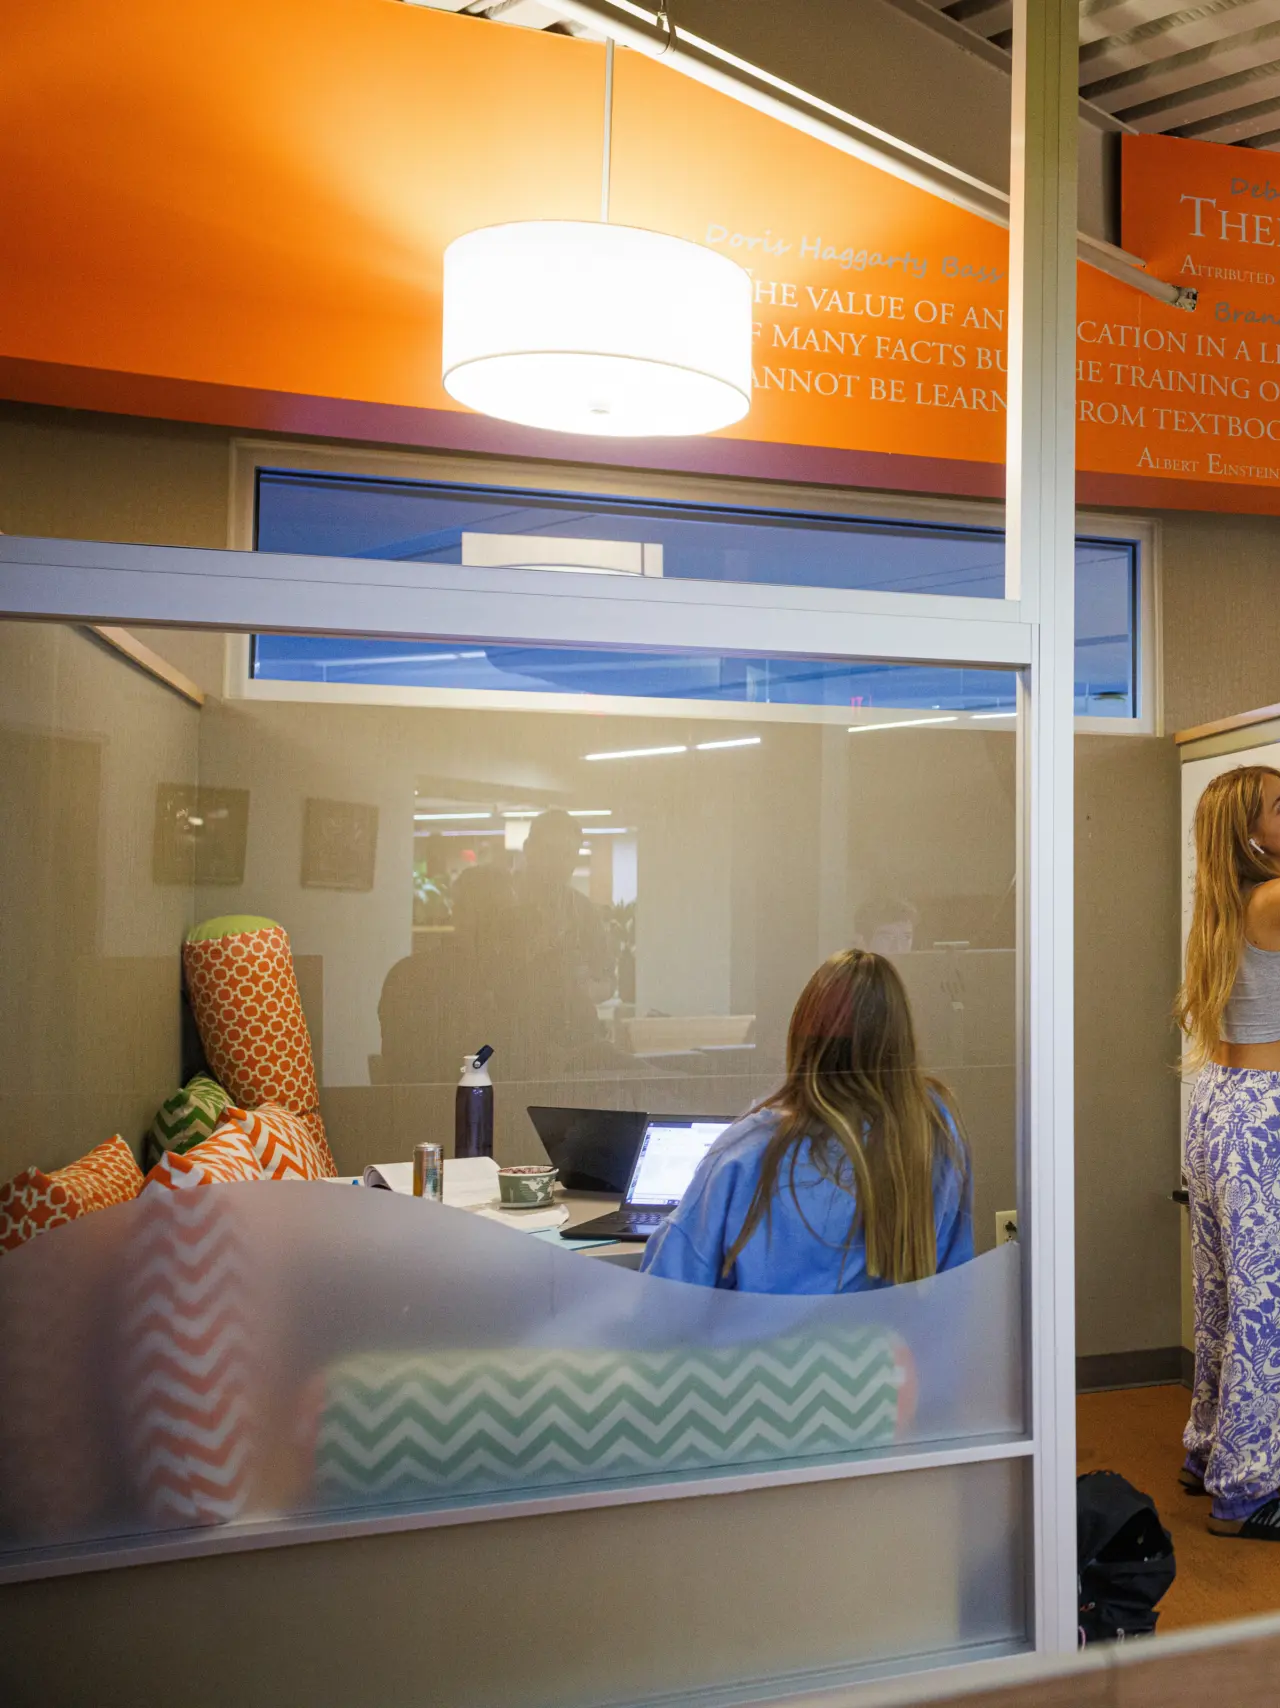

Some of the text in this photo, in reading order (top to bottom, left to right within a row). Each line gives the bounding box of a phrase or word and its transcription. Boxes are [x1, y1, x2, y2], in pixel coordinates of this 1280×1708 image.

[705, 223, 791, 257] Doris
[801, 236, 928, 280] Haggarty
[745, 266, 798, 308] HE
[805, 286, 906, 322] VALUE
[913, 299, 955, 326] OF
[960, 306, 1005, 331] AN
[1077, 320, 1187, 353] CATION
[1195, 334, 1227, 359] IN
[1234, 340, 1251, 363] A
[752, 364, 860, 398] ANNOT
[869, 376, 907, 403] BE
[915, 380, 1008, 412] LEARN
[1079, 399, 1147, 428] ROM
[771, 323, 868, 356] MANY
[874, 336, 967, 368] FACTS
[976, 347, 1008, 373] BU
[1076, 359, 1104, 384] HE
[1110, 363, 1251, 400] TRAINING
